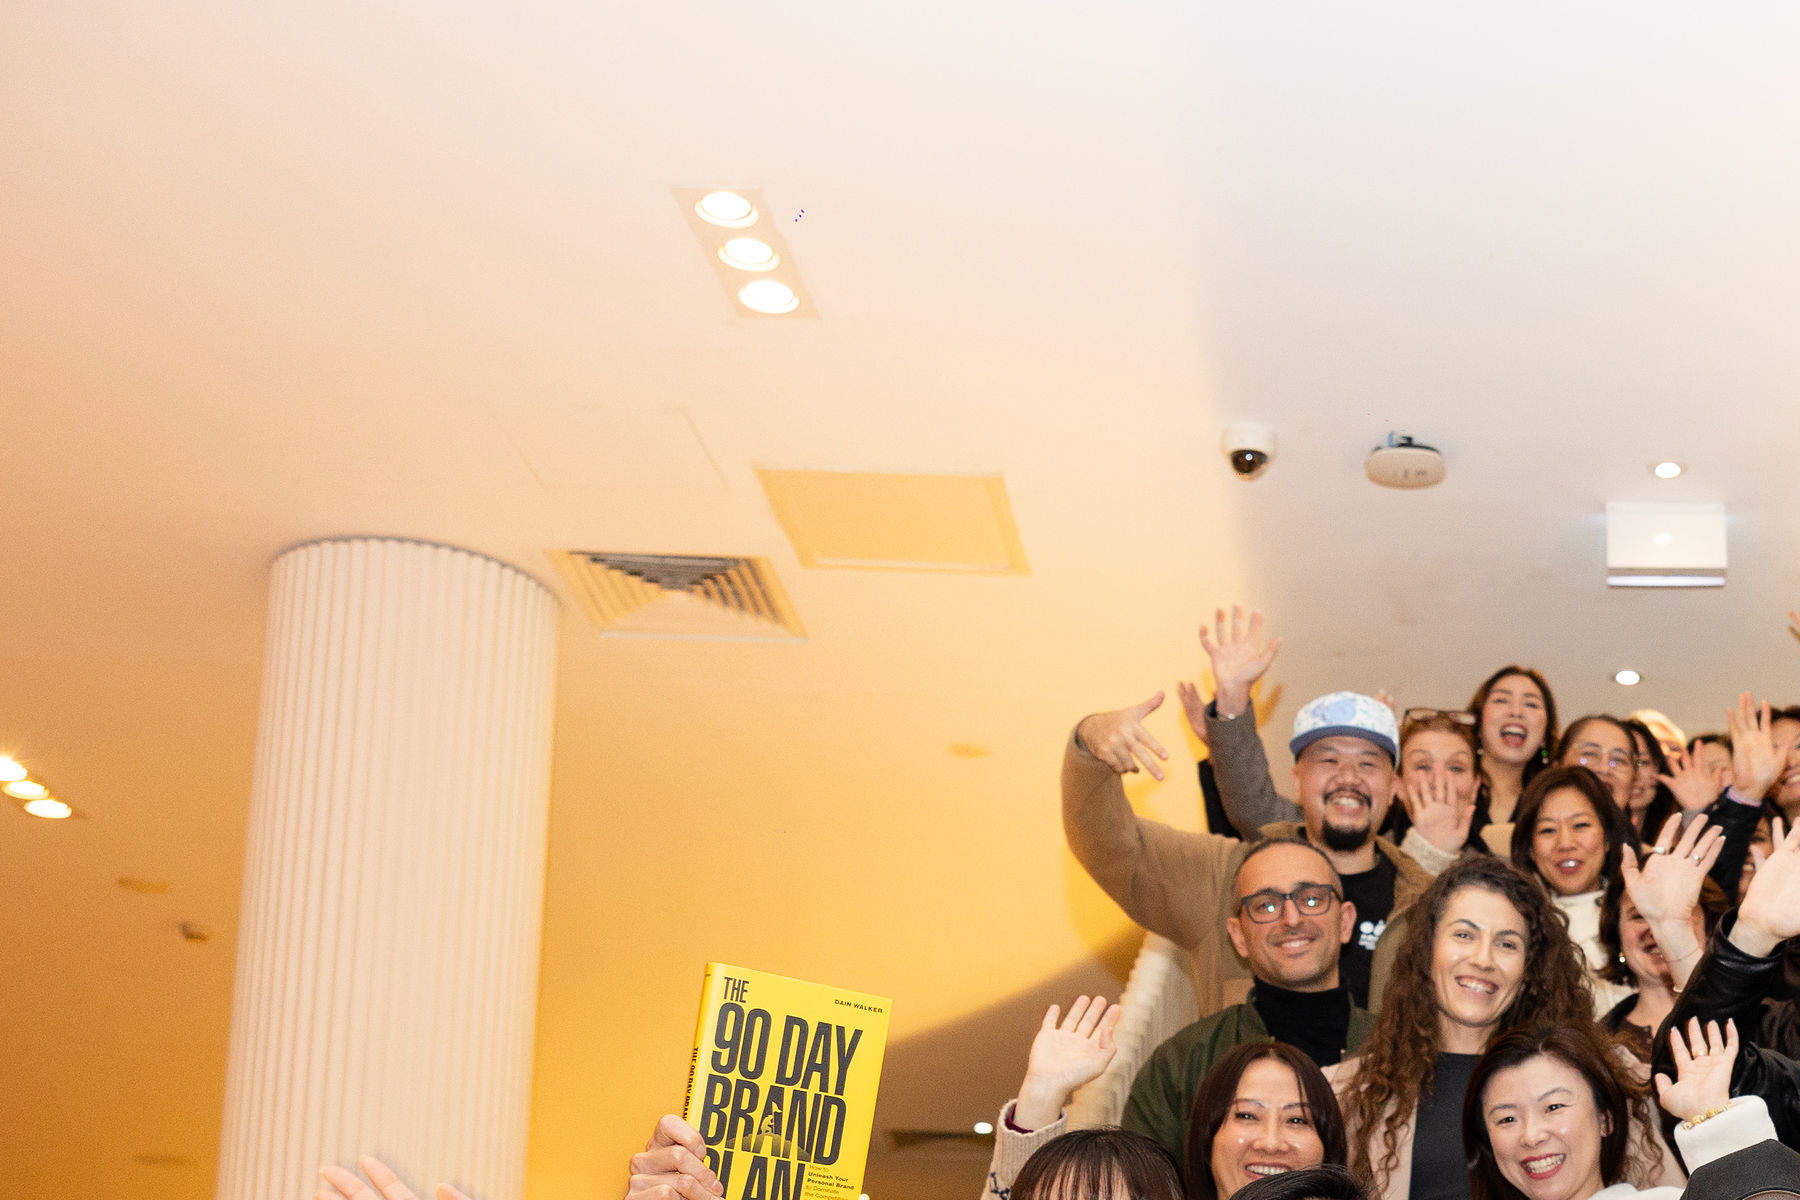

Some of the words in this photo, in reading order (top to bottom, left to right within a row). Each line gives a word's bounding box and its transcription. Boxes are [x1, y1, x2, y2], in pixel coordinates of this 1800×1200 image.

[724, 977, 749, 1004] THE
[834, 999, 852, 1008] DAIN
[854, 1002, 883, 1013] WALKER
[711, 1002, 772, 1079] 90
[776, 1015, 863, 1096] DAY
[700, 1074, 846, 1166] BRAND
[807, 1178, 834, 1186] Personal
